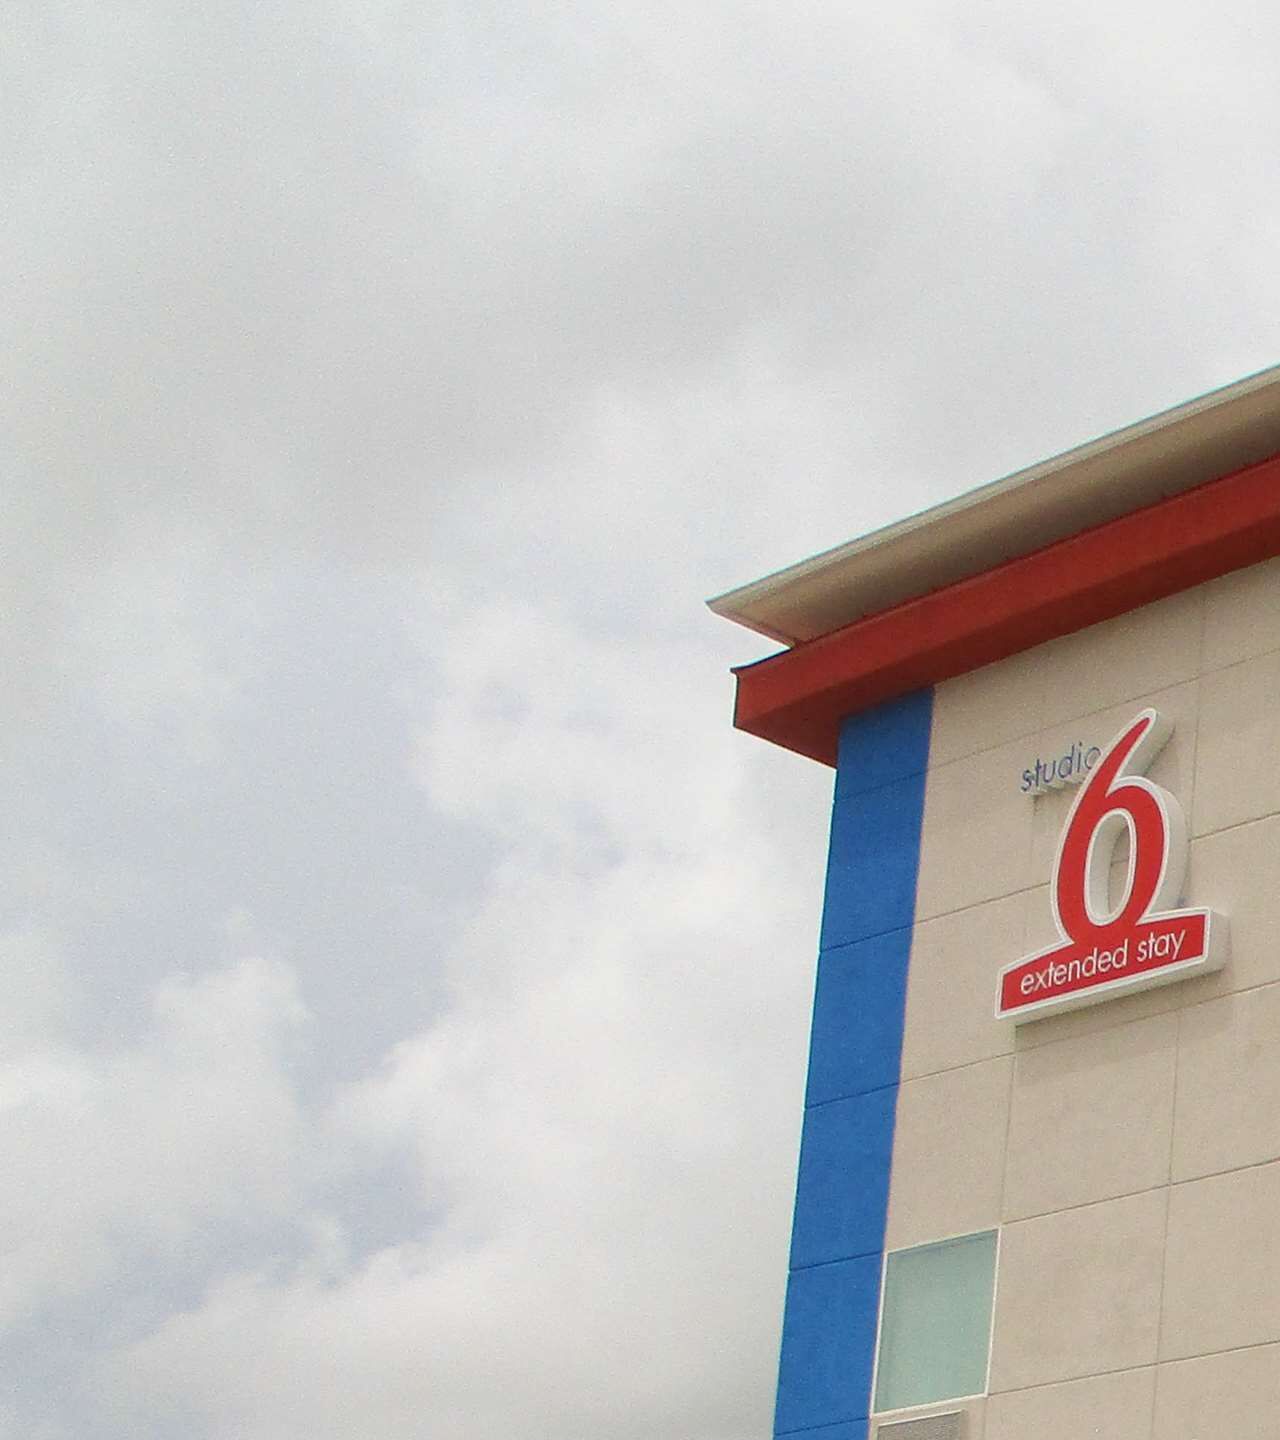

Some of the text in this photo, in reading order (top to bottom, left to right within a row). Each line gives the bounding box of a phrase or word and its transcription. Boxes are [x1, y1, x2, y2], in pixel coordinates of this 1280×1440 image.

[1020, 740, 1102, 792] studio
[1053, 709, 1169, 936] 6
[1019, 929, 1186, 995] extended stay
